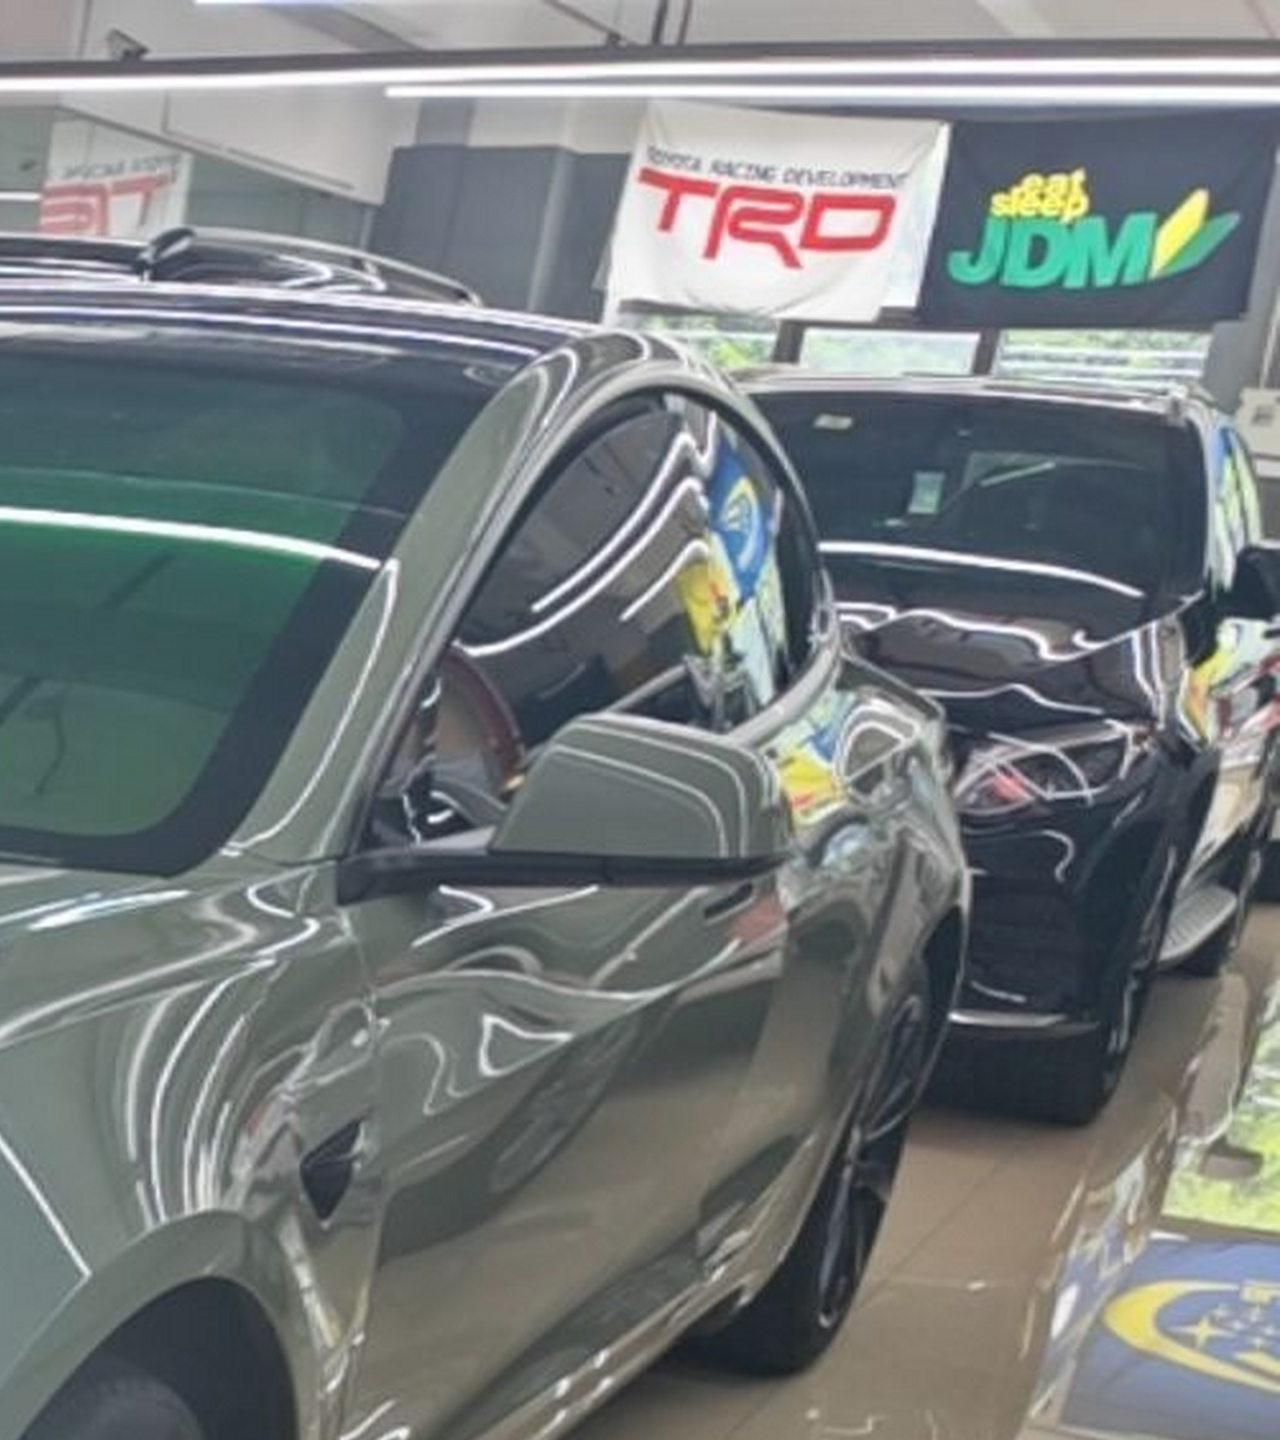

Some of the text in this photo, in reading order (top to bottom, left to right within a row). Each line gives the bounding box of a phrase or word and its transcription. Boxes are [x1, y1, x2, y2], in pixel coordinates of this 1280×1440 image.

[647, 147, 907, 187] TOYOTA RACING DEVELOPMENT
[1021, 167, 1087, 194] eat
[637, 168, 896, 268] TRD
[991, 186, 1090, 225] sleep
[948, 212, 1158, 288] JDM
